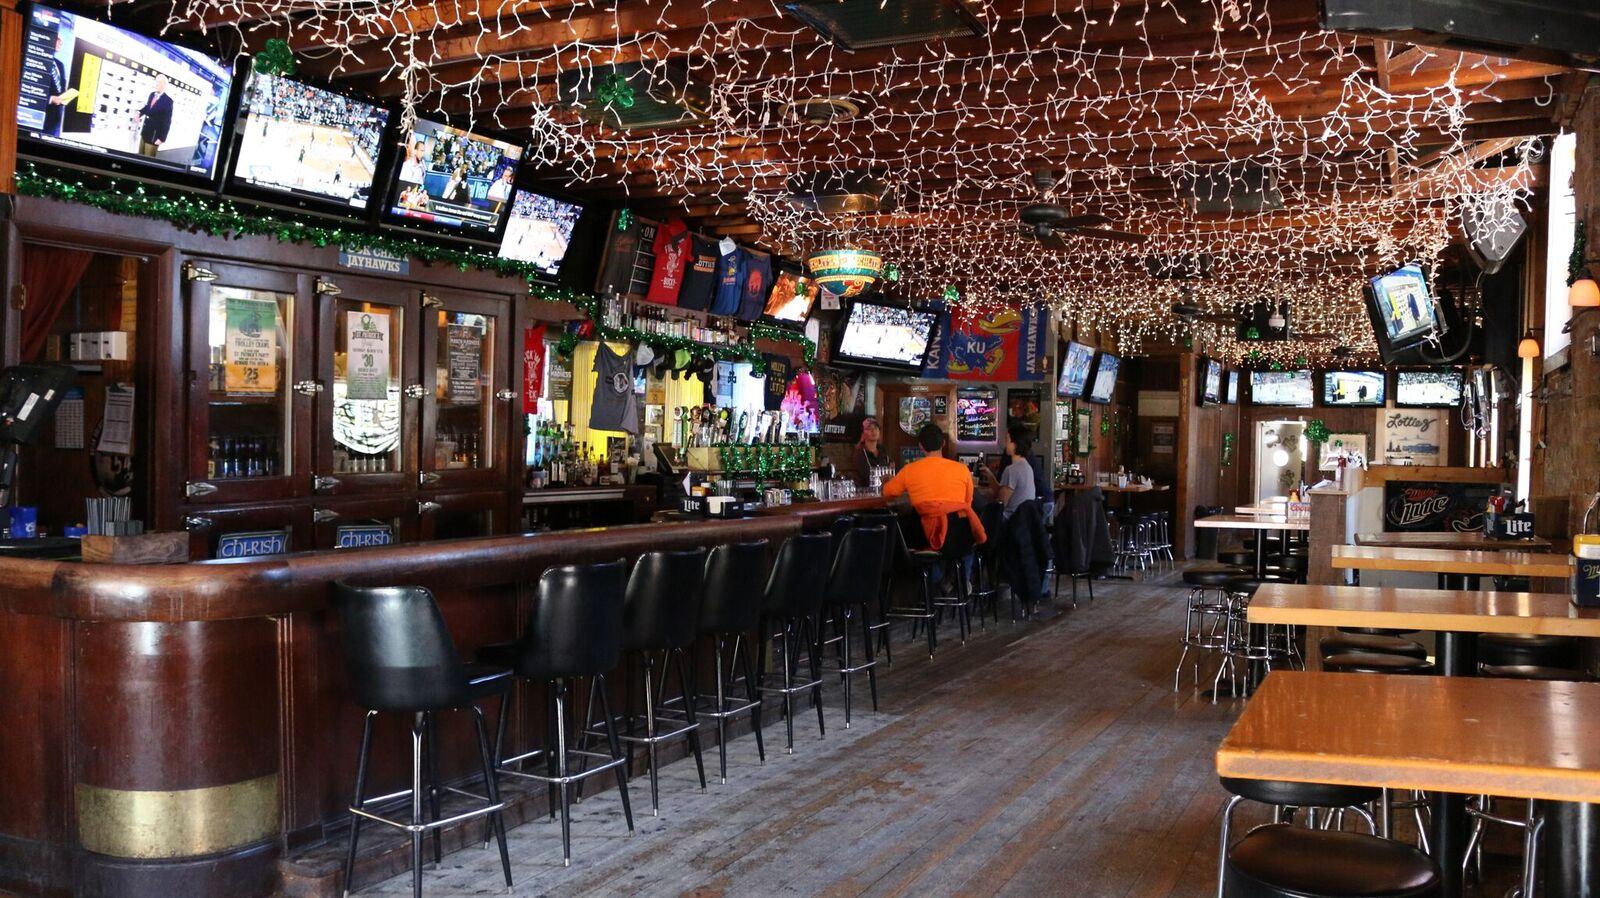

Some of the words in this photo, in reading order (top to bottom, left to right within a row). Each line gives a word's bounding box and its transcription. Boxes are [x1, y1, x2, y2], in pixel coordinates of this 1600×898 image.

[346, 254, 400, 273] JAYHAWKS
[967, 341, 986, 354] KU
[1026, 307, 1038, 374] JAYHAWKS
[684, 499, 700, 512] Lite
[1399, 497, 1449, 525] Lite
[1504, 519, 1532, 536] Lite
